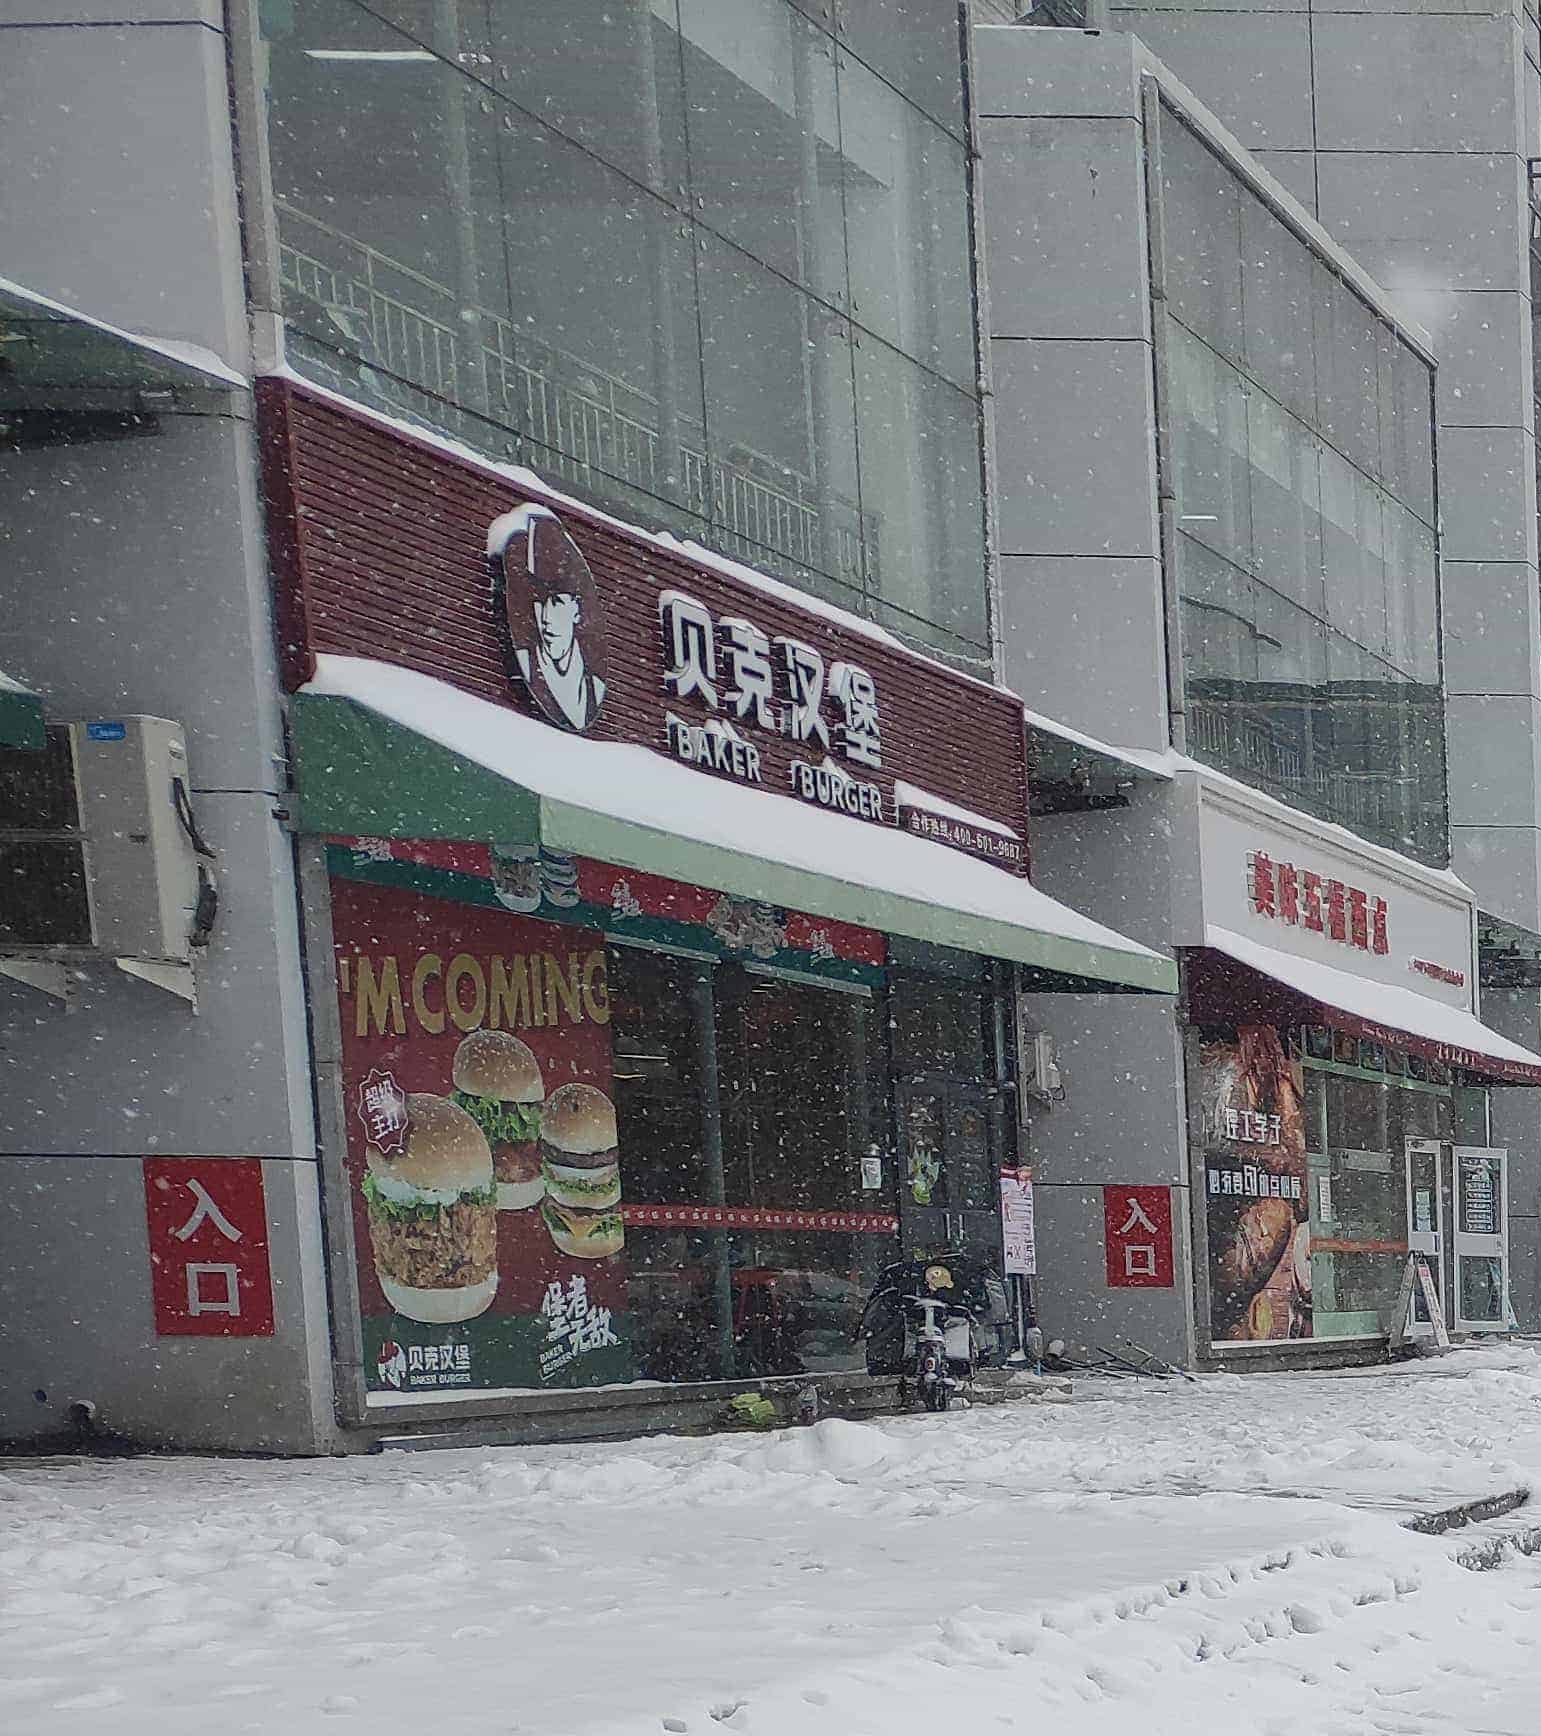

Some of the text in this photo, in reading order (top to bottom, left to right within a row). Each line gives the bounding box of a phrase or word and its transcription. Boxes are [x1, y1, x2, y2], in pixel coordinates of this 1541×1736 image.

[665, 592, 882, 768] 贝克汉堡
[676, 722, 883, 821] BAKER BURGER
[412, 951, 611, 1034] COMING
[174, 1178, 243, 1316] 入口
[1120, 1198, 1159, 1277] 入口
[409, 1344, 470, 1370] 贝克汉堡
